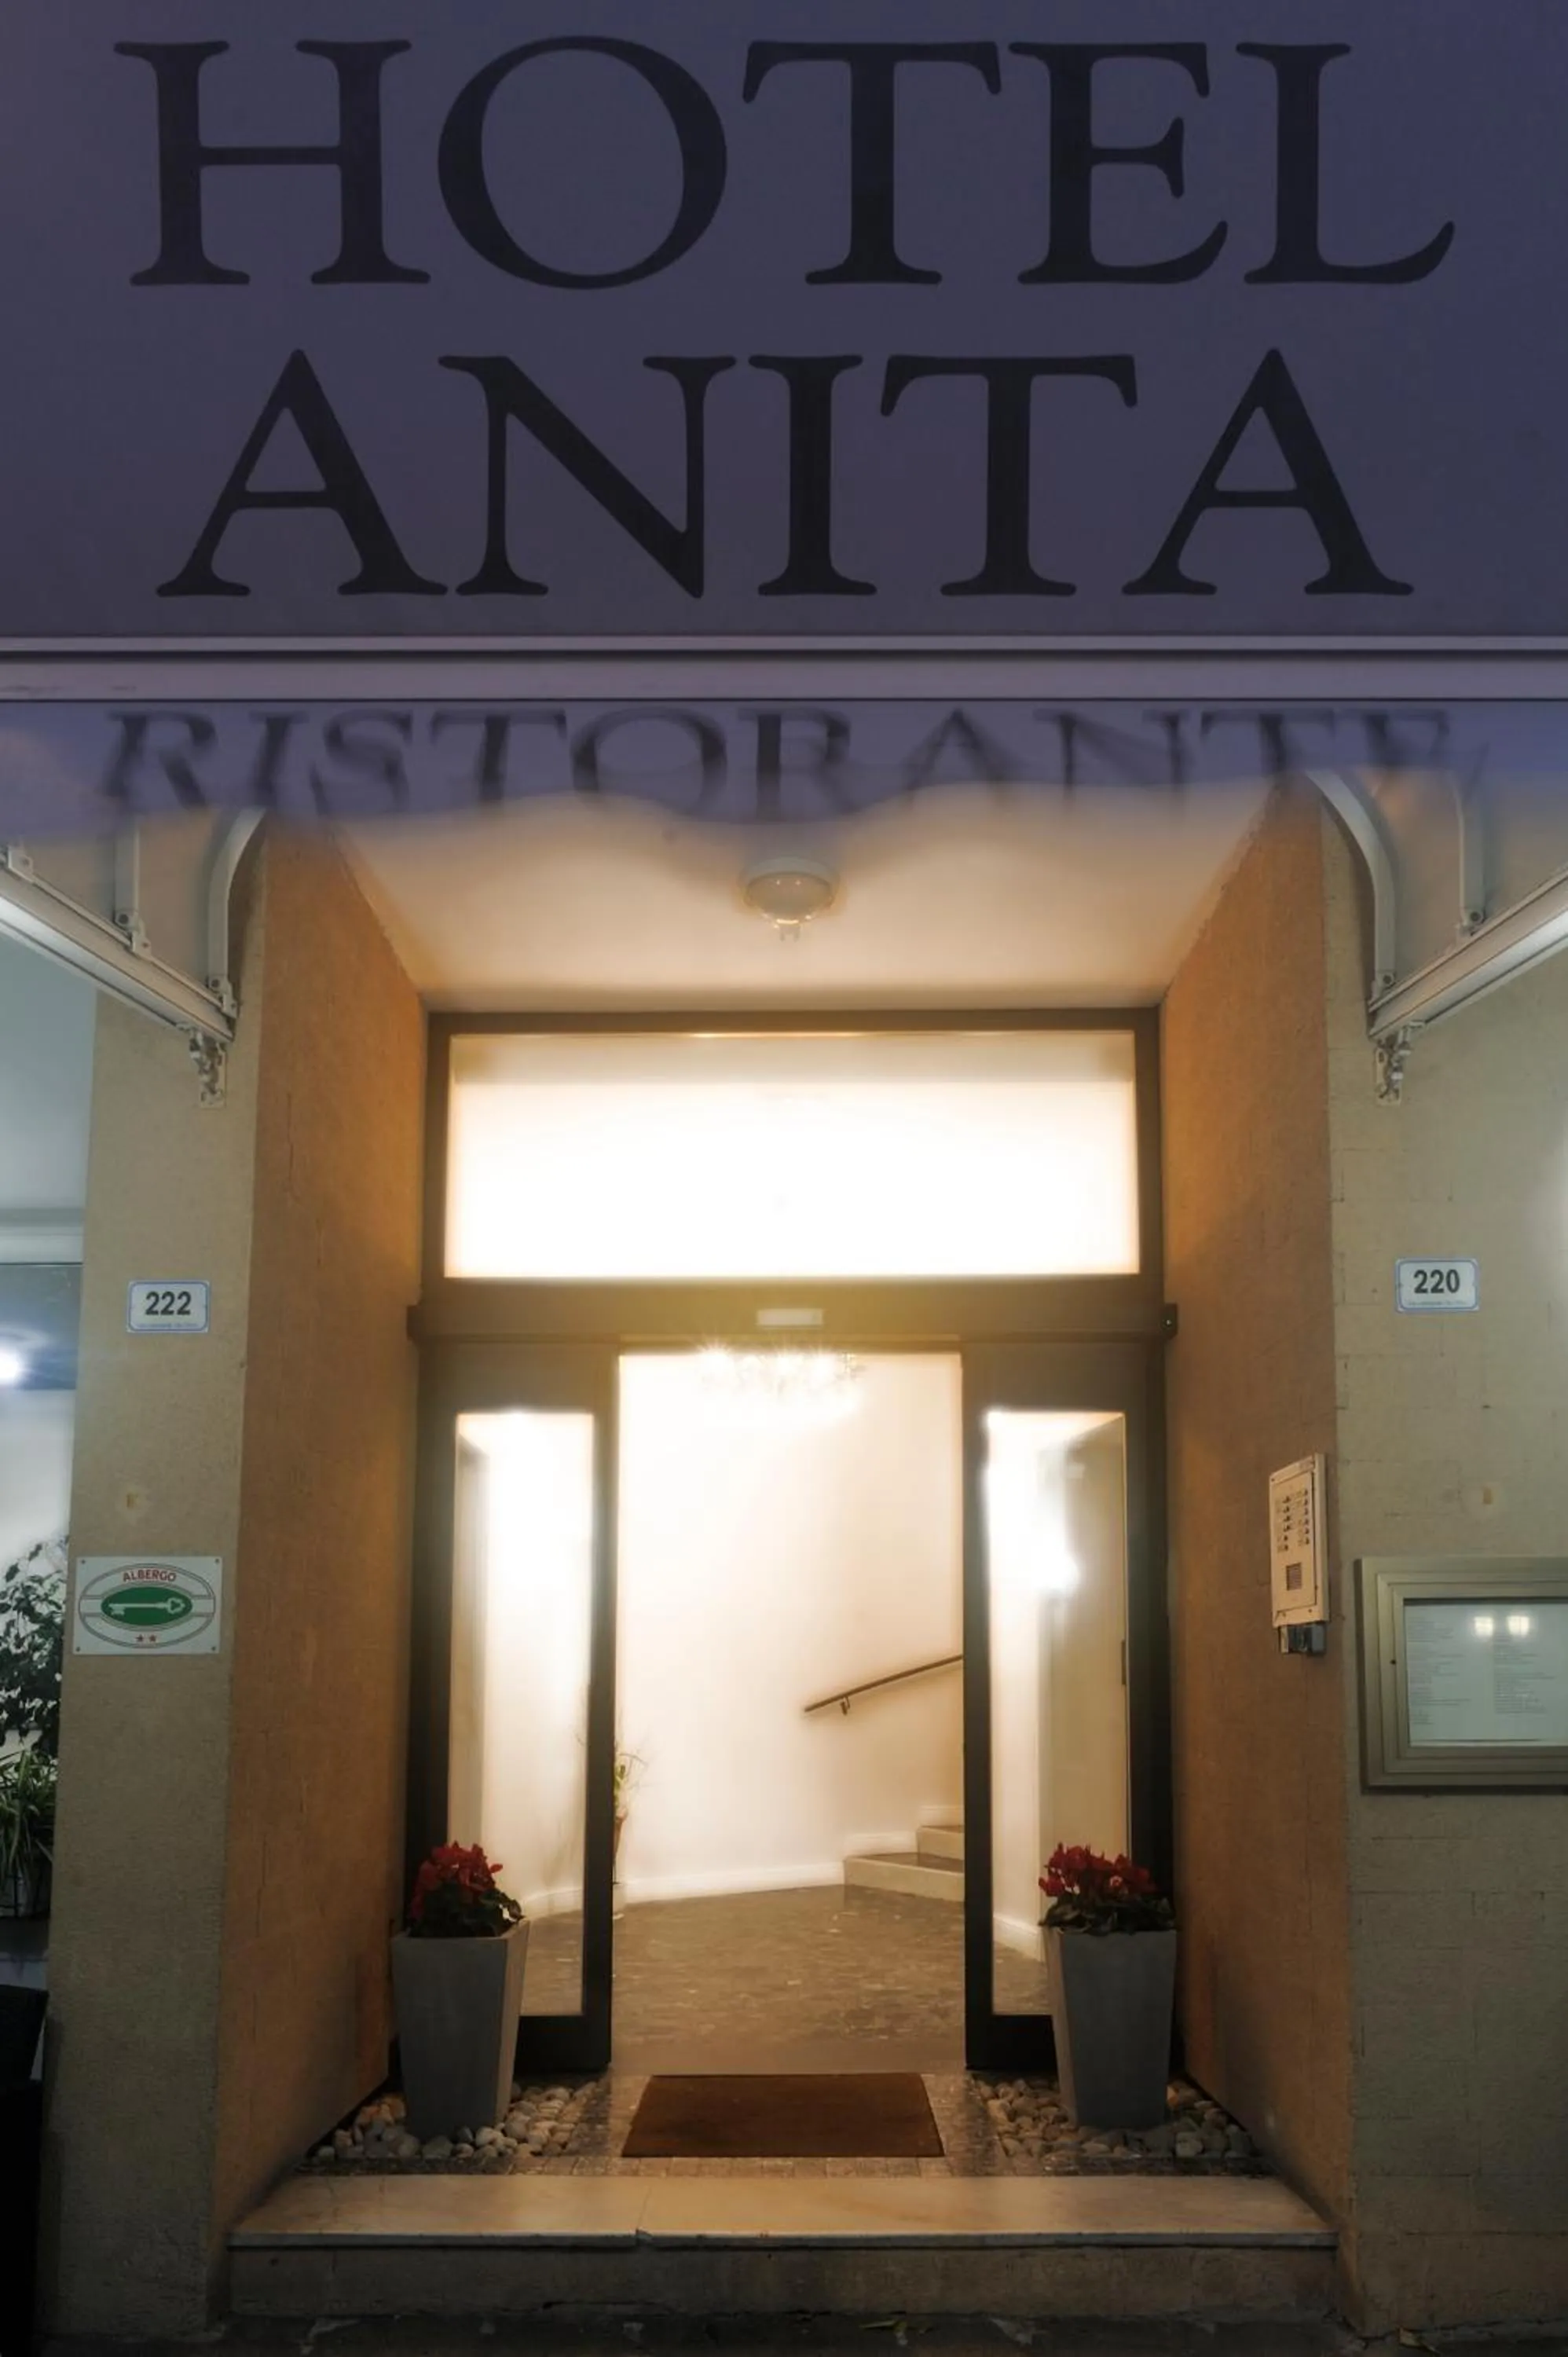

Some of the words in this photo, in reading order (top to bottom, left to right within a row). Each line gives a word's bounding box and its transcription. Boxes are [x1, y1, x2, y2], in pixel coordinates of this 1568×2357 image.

[114, 35, 1456, 291] HOTEL
[156, 348, 1414, 599] ANITA
[1413, 1269, 1460, 1294] 220
[145, 1291, 192, 1316] 222
[123, 1569, 177, 1582] ALBERGO
